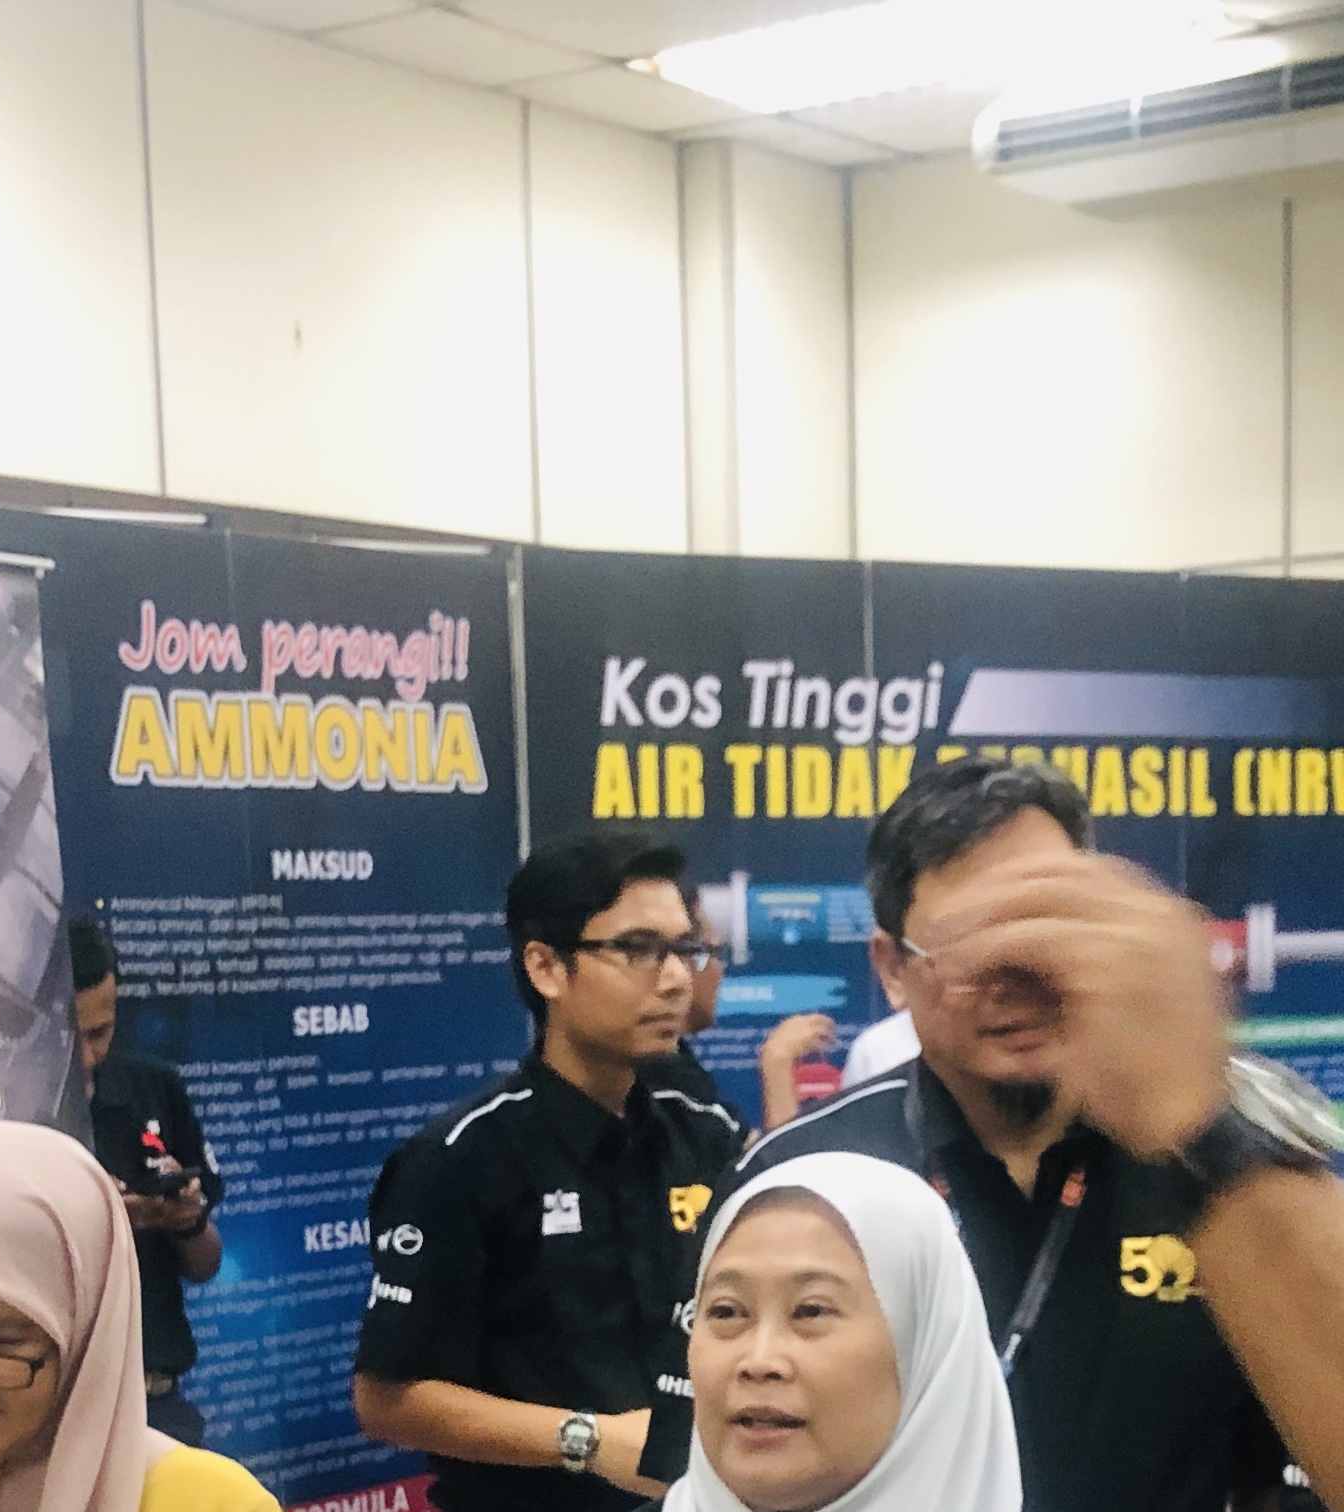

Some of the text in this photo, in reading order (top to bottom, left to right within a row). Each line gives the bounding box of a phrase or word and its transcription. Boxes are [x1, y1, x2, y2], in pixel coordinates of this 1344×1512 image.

[118, 599, 248, 674] Jom
[598, 655, 945, 746] Kos Tinggi
[110, 685, 489, 795] AMMONIA
[592, 742, 706, 819] AIR
[723, 742, 917, 819] TIDAK
[271, 849, 374, 881] MAKSUD
[292, 1003, 370, 1037] SEBAB
